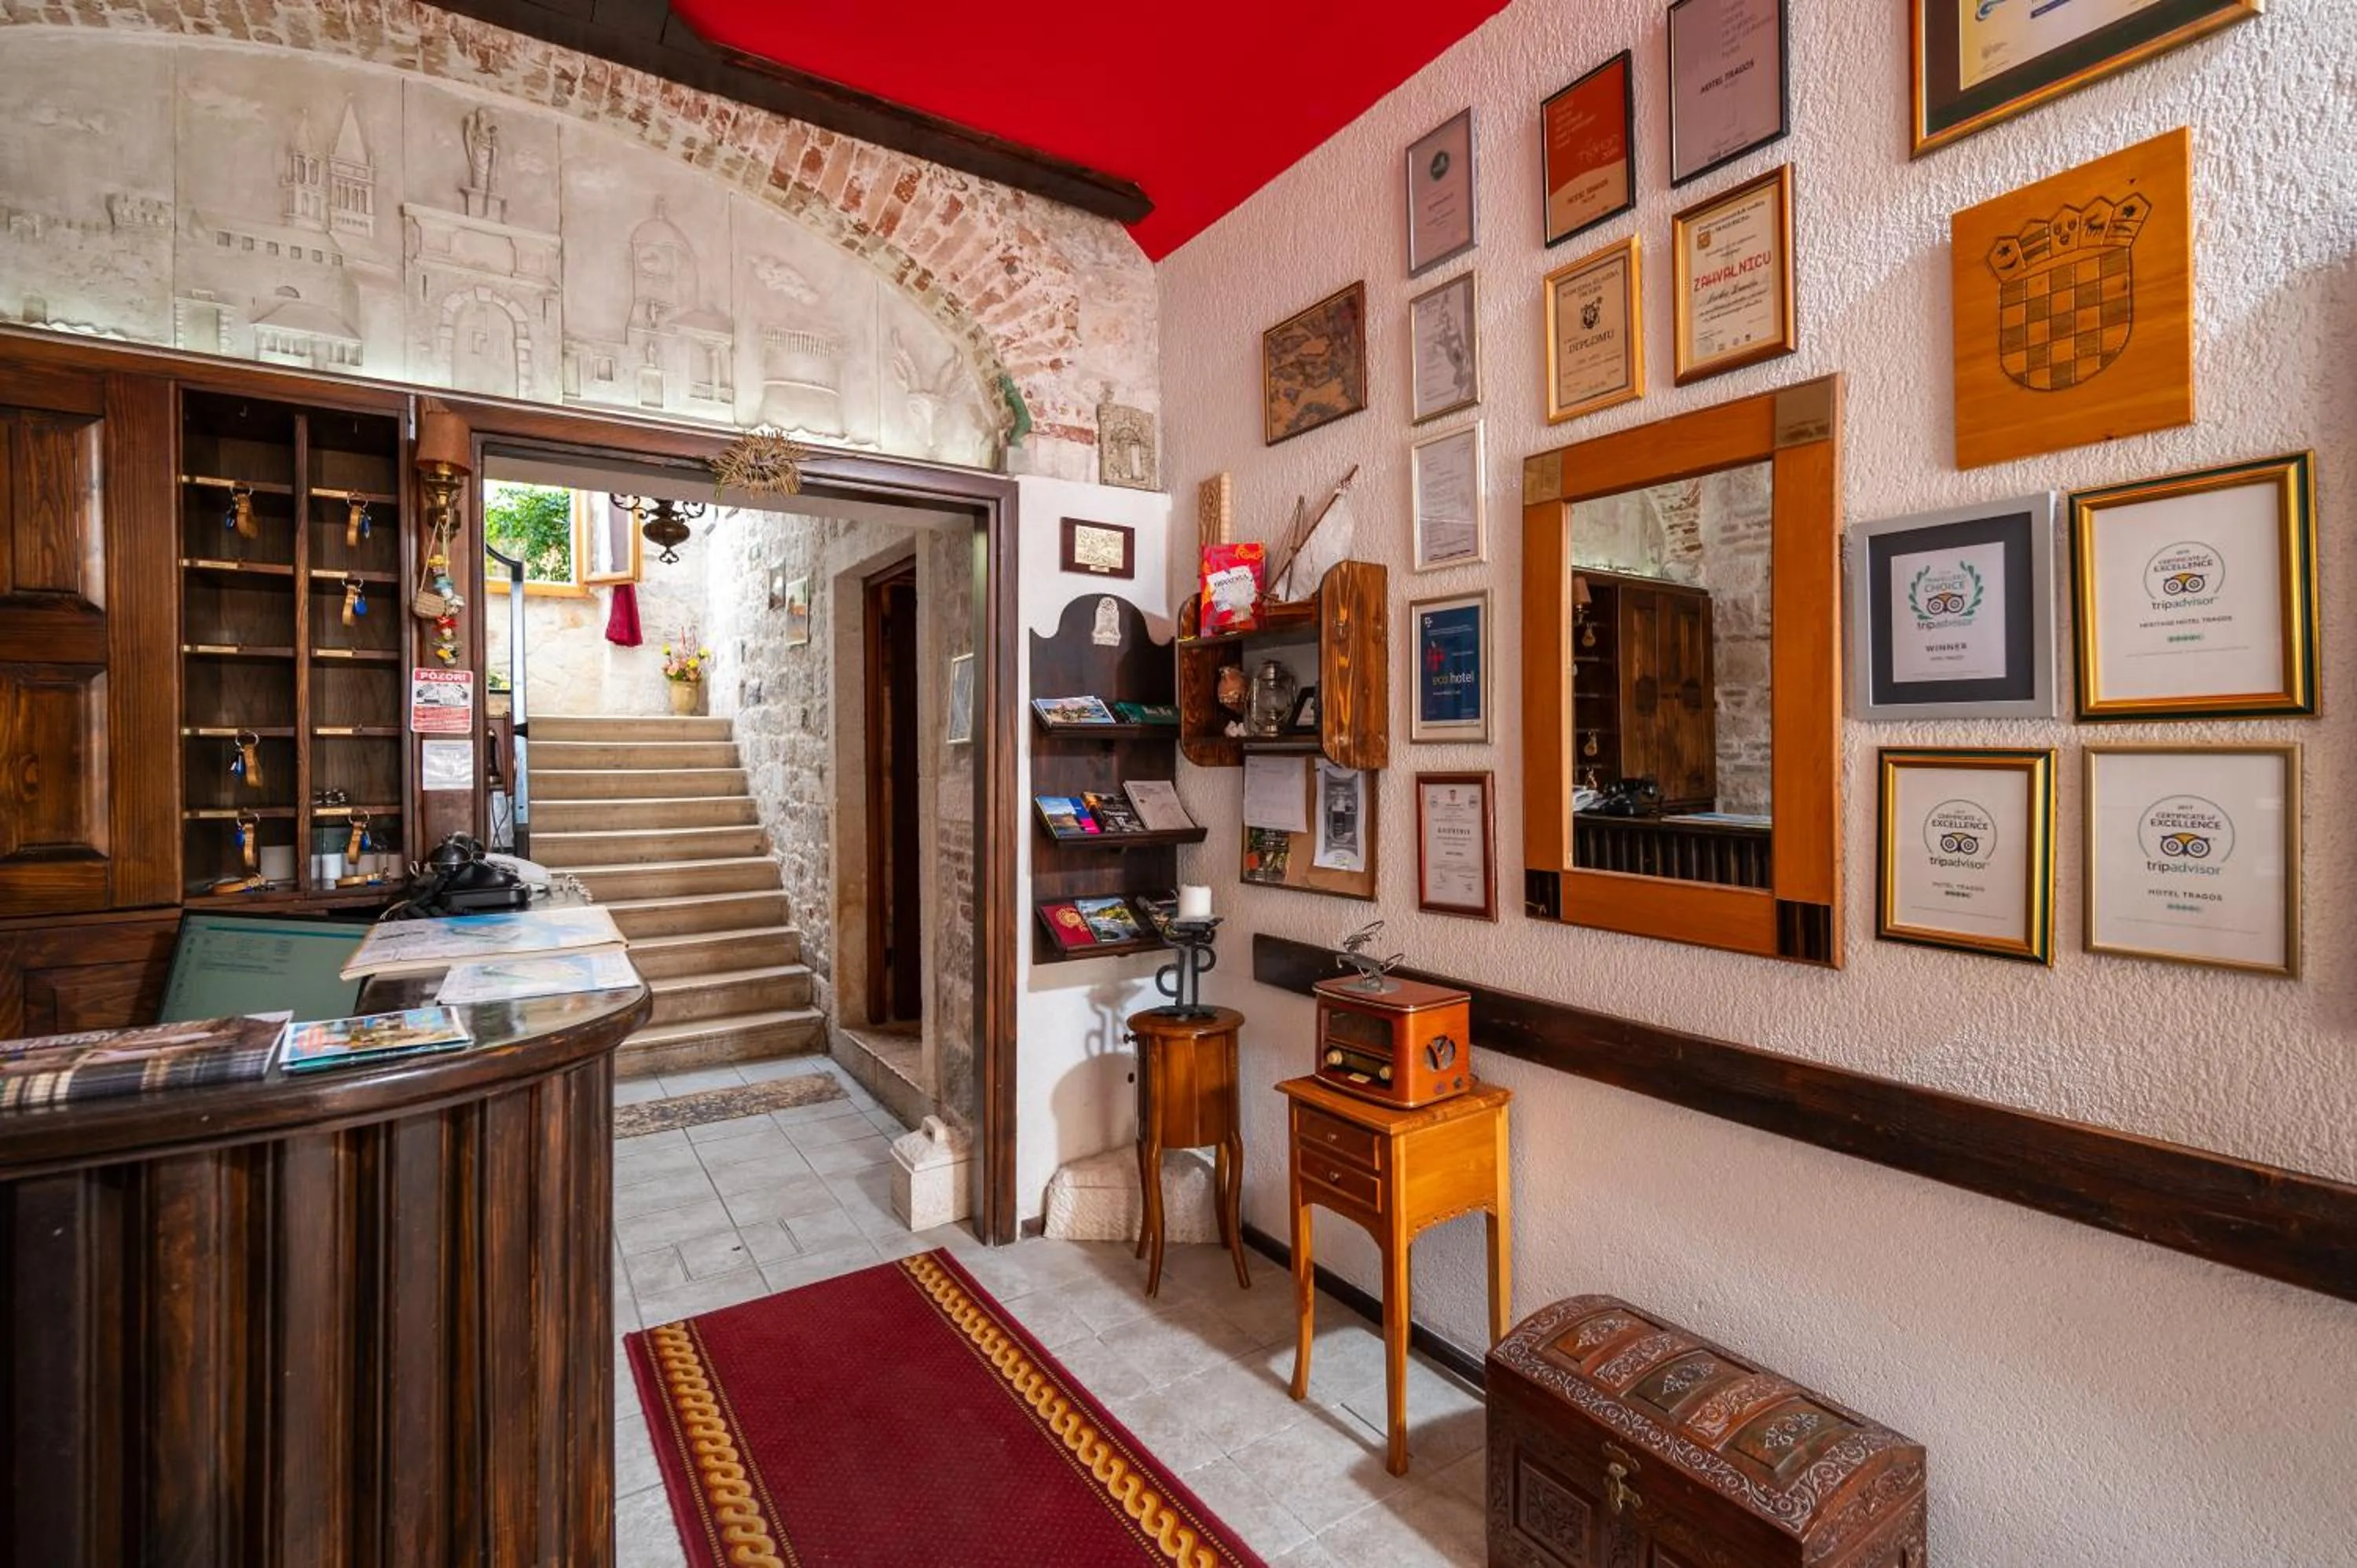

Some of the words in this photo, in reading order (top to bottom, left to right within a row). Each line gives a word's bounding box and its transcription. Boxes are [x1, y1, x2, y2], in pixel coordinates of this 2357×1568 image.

[2154, 559, 2213, 572] EXCELLENCE
[2151, 597, 2215, 610] tripadvisor
[1926, 642, 1967, 653] WINNER
[1450, 671, 1475, 684] hotel
[1931, 819, 1989, 830] EXCELLENCE
[2150, 818, 2222, 830] EXCELLENCE
[1930, 855, 1986, 870] tripadvisor
[2146, 861, 2221, 875] tripadvisor
[2148, 888, 2179, 898] HOTEL
[2183, 891, 2223, 901] TRAGOS
